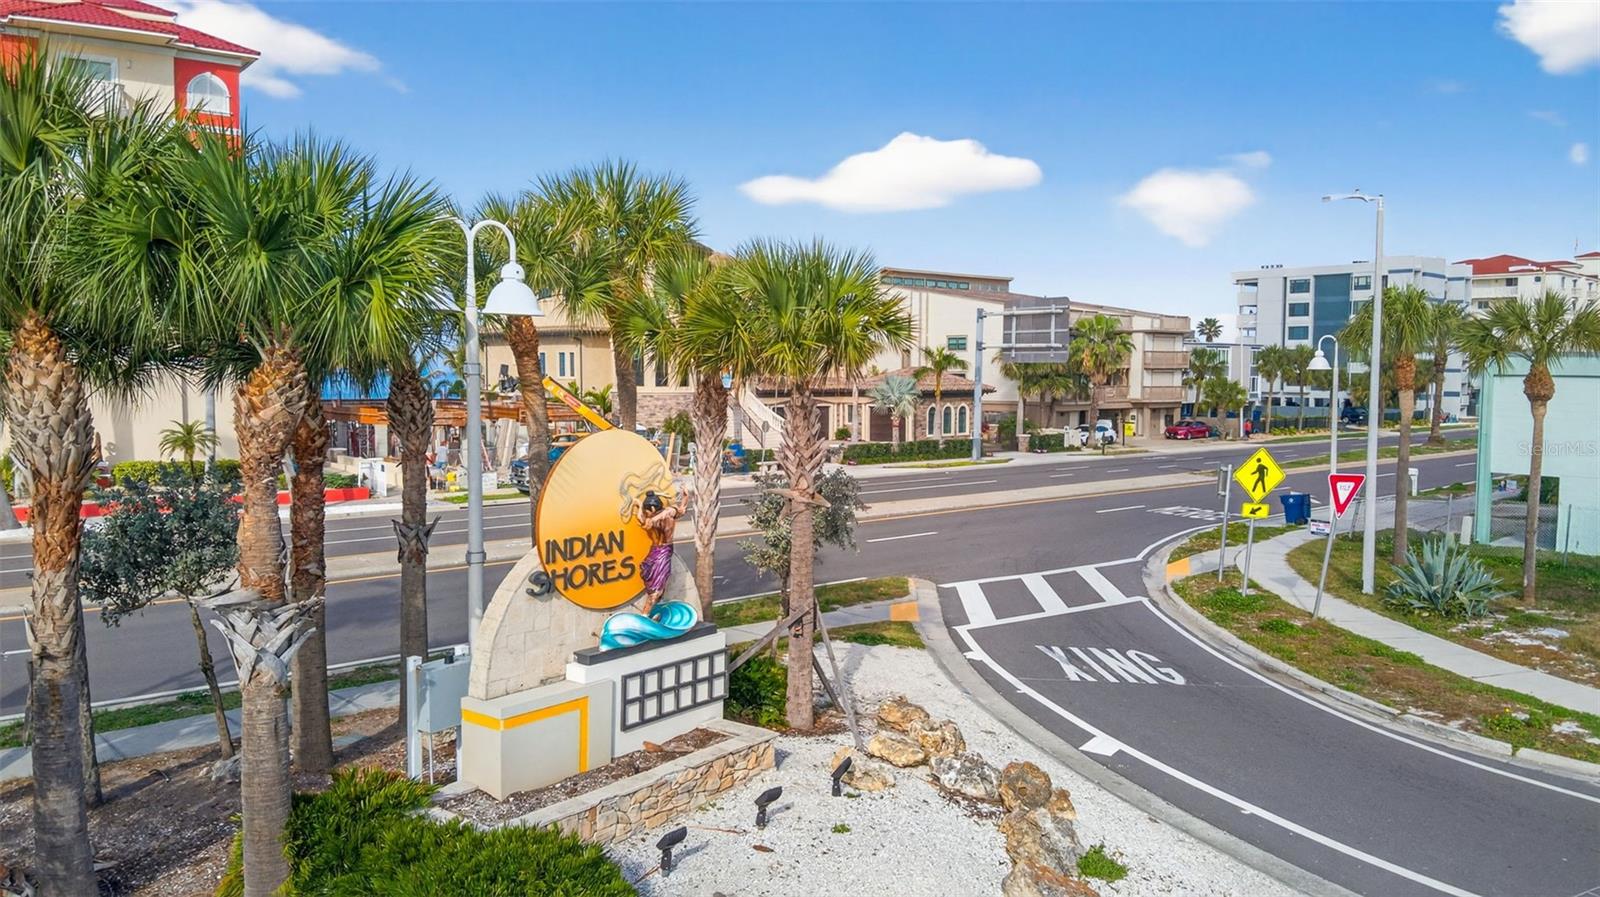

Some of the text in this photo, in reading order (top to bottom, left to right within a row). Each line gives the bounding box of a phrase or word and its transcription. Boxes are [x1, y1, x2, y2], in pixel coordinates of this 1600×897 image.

[545, 529, 624, 565] INDIAN
[526, 556, 636, 597] SHORES
[1035, 645, 1186, 685] XING
